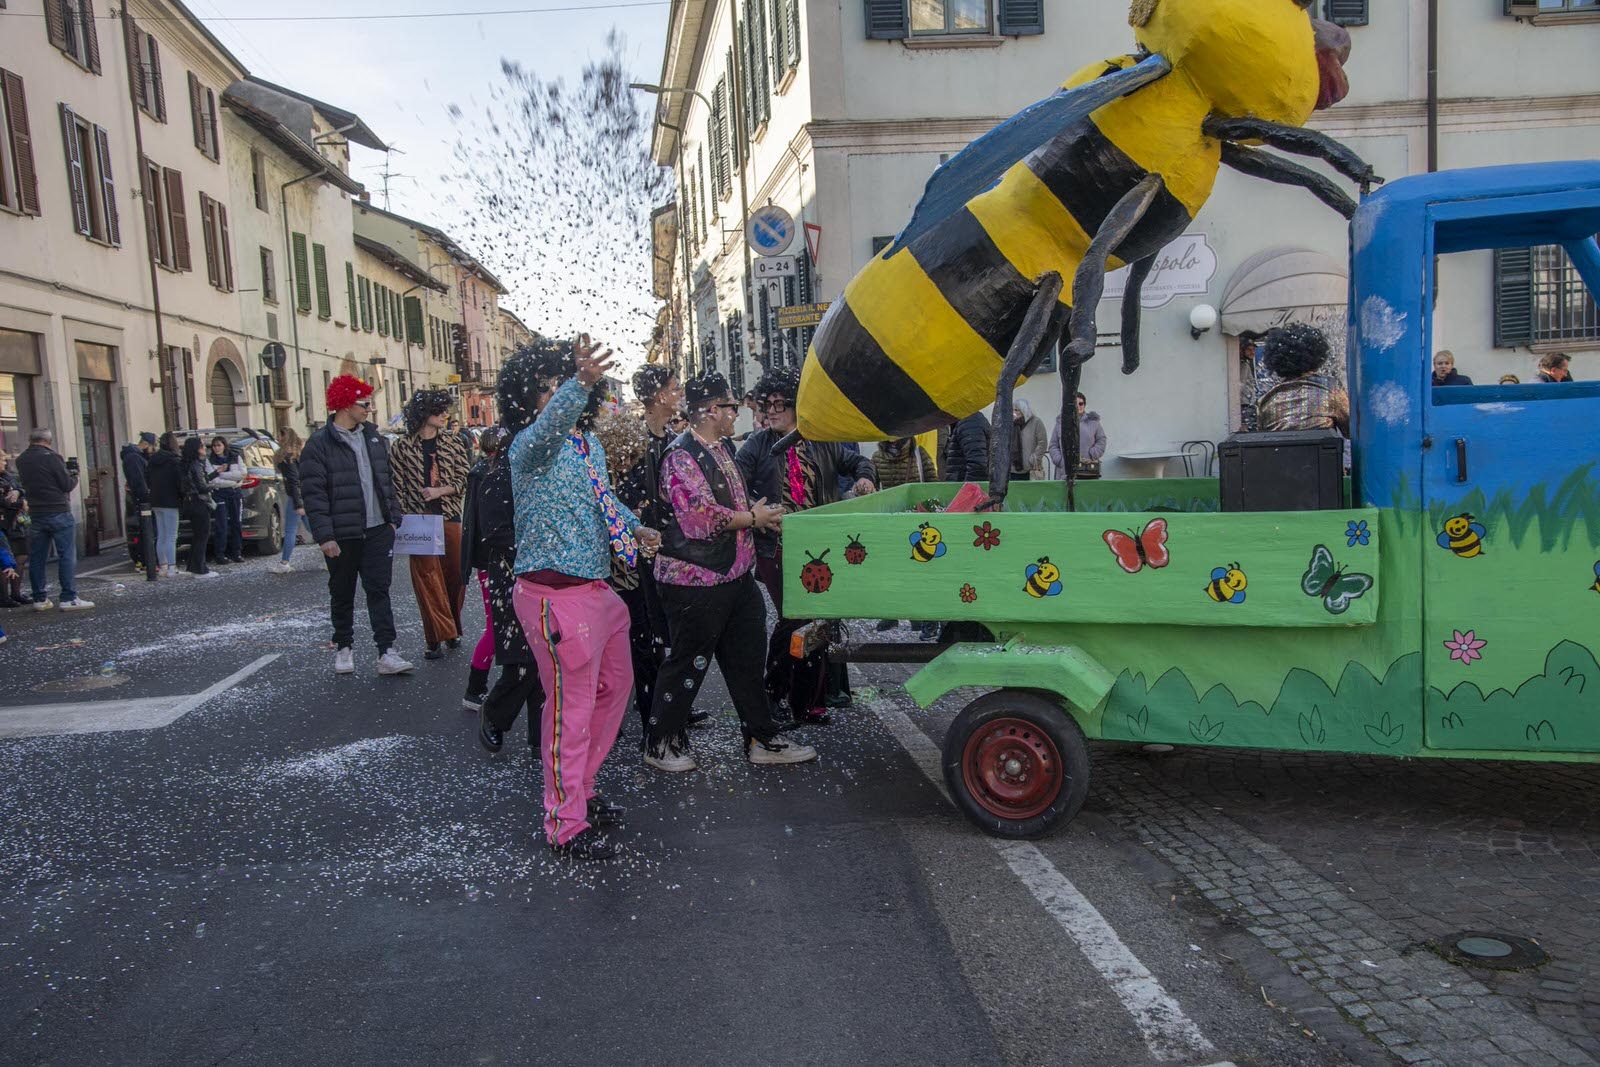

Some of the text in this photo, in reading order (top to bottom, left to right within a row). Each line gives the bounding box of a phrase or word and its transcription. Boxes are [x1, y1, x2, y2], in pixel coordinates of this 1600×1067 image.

[1151, 242, 1200, 285] spolo
[779, 314, 820, 324] RISTORANTE
[404, 533, 432, 542] Colombo
